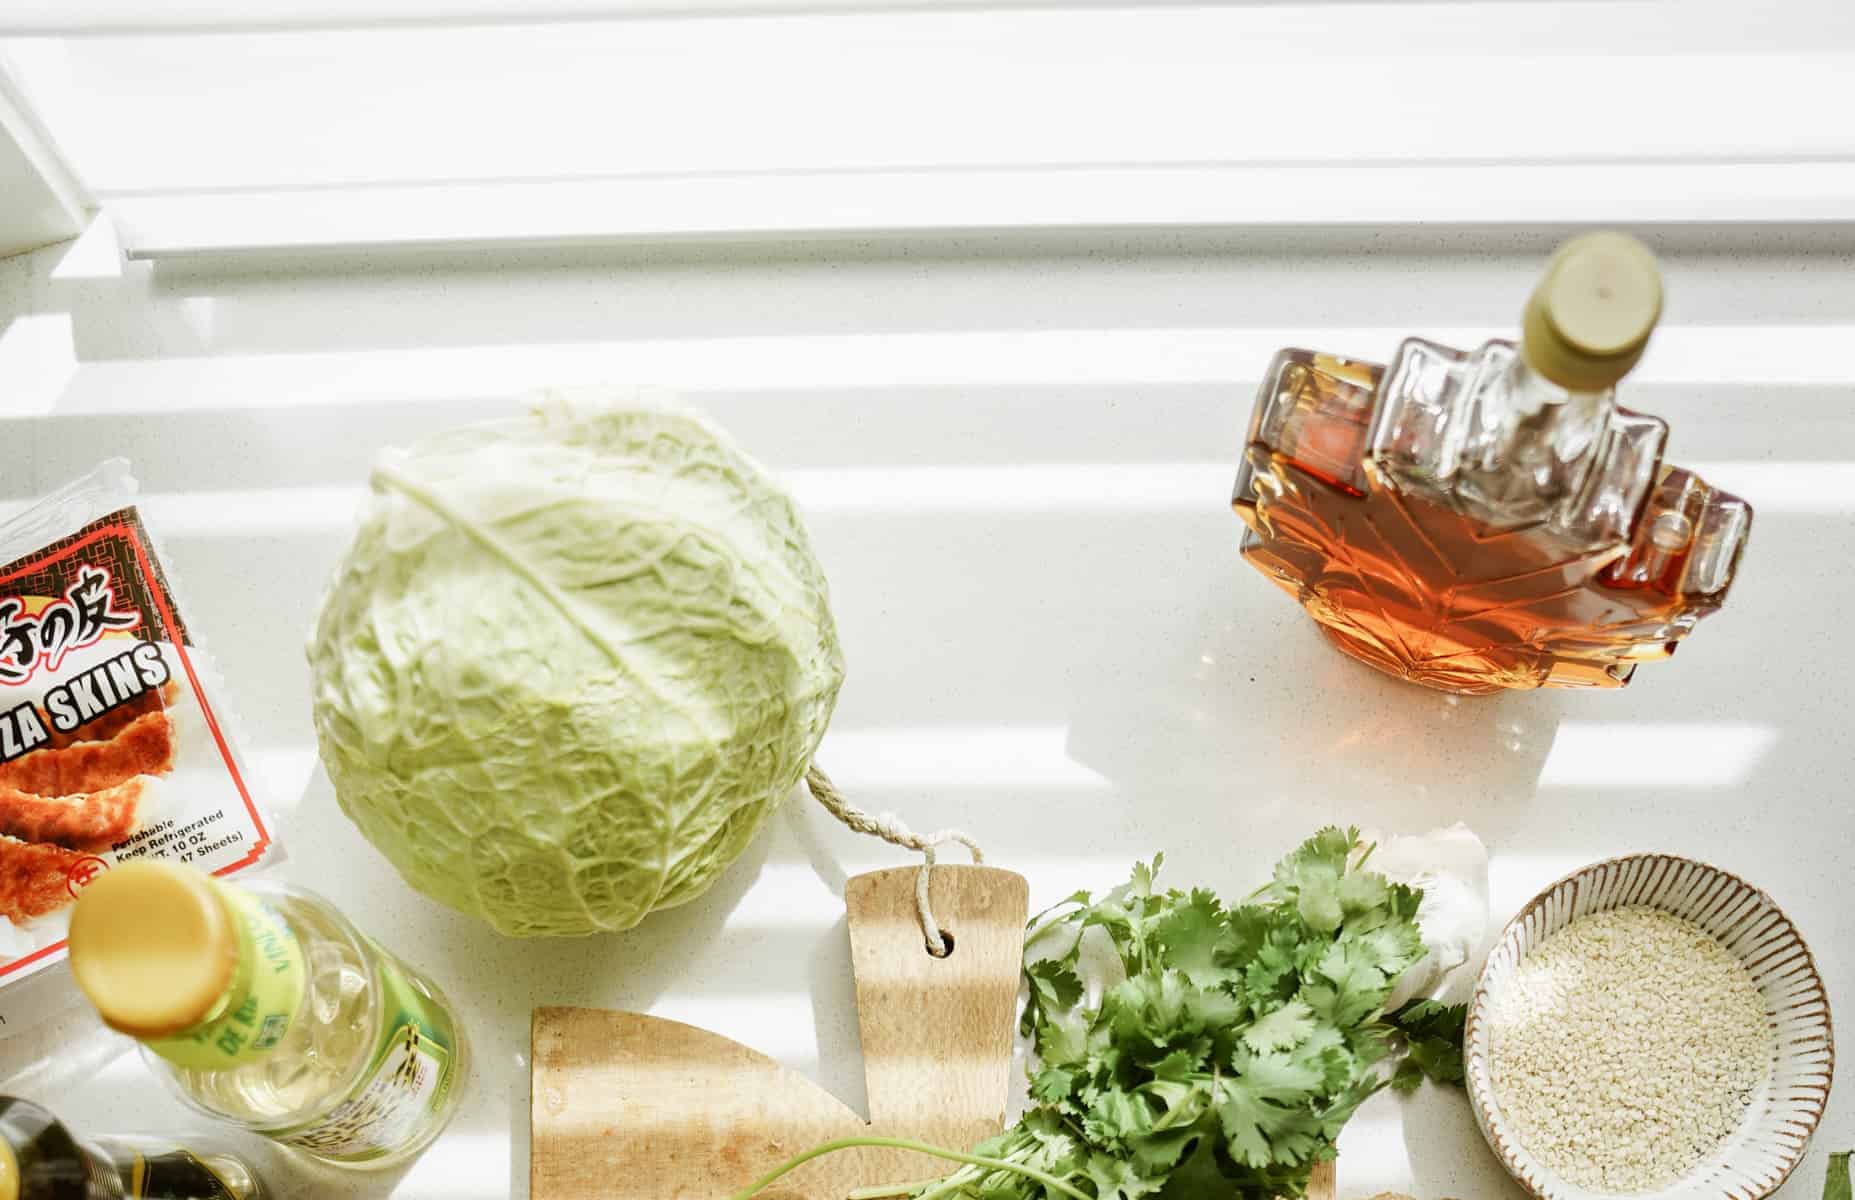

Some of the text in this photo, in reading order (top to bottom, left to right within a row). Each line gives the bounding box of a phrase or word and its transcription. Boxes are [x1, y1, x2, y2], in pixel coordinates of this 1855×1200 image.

[46, 643, 168, 733] SKINS
[111, 819, 175, 852] Perishable
[116, 809, 225, 863] Keep Refrigerated
[172, 842, 187, 853] 10
[189, 831, 208, 845] OZ
[180, 831, 244, 864] 47 Sheets)
